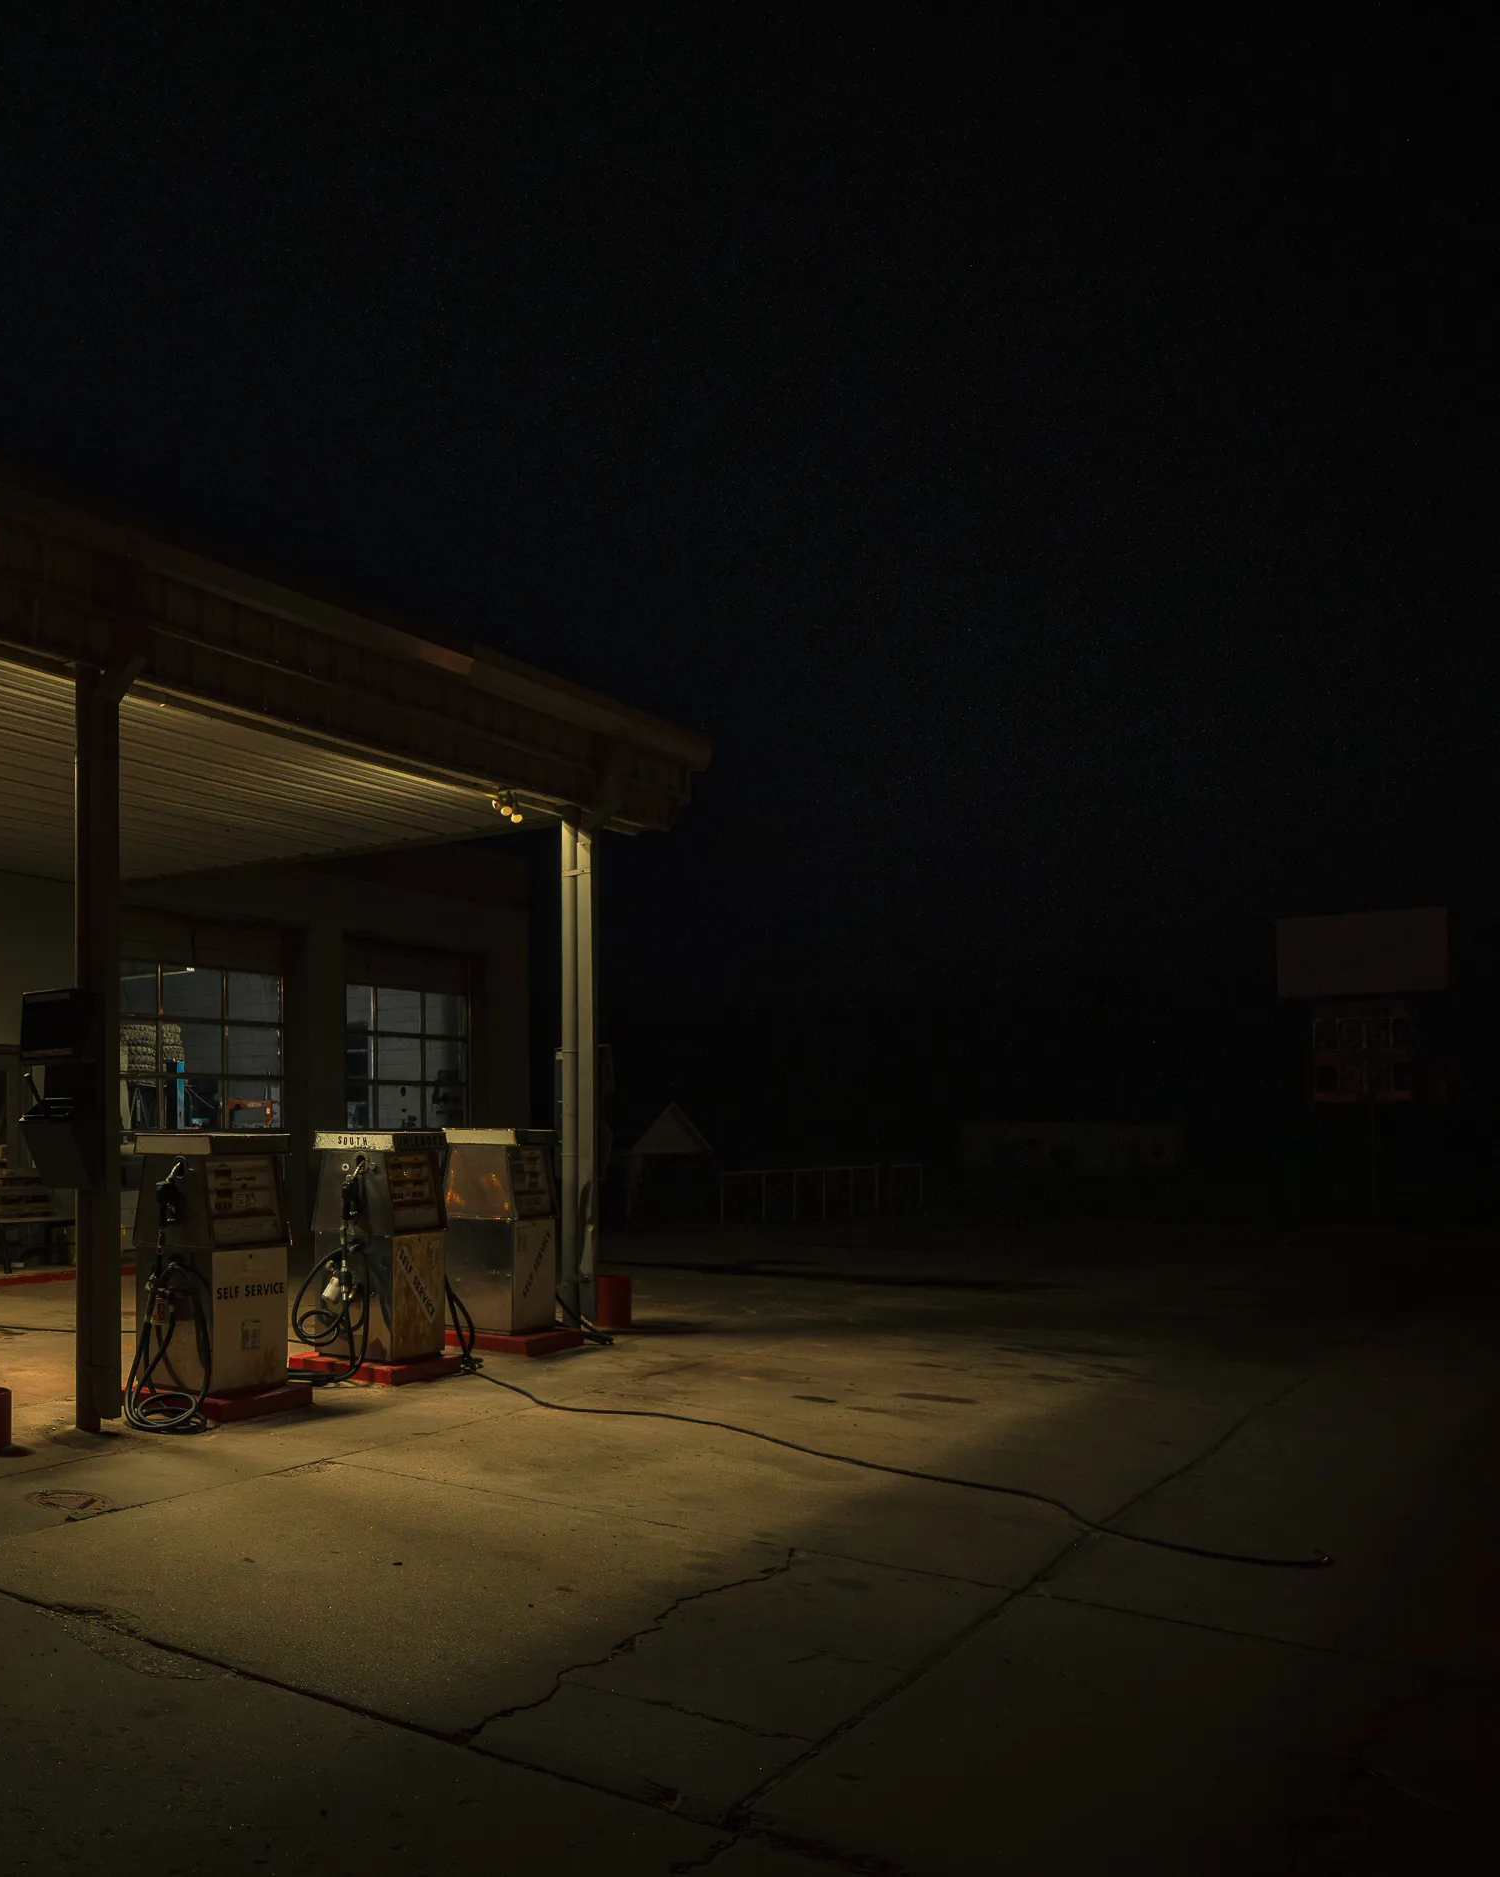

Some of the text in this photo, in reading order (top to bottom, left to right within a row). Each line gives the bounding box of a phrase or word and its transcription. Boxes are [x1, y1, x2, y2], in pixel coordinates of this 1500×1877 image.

[337, 1136, 368, 1146] SOUTH
[396, 1135, 444, 1147] UNLEADED
[522, 1231, 551, 1299] SELF SERVICE
[216, 1282, 285, 1300] SELF SERVICE
[398, 1249, 436, 1319] SELF SERVICE
